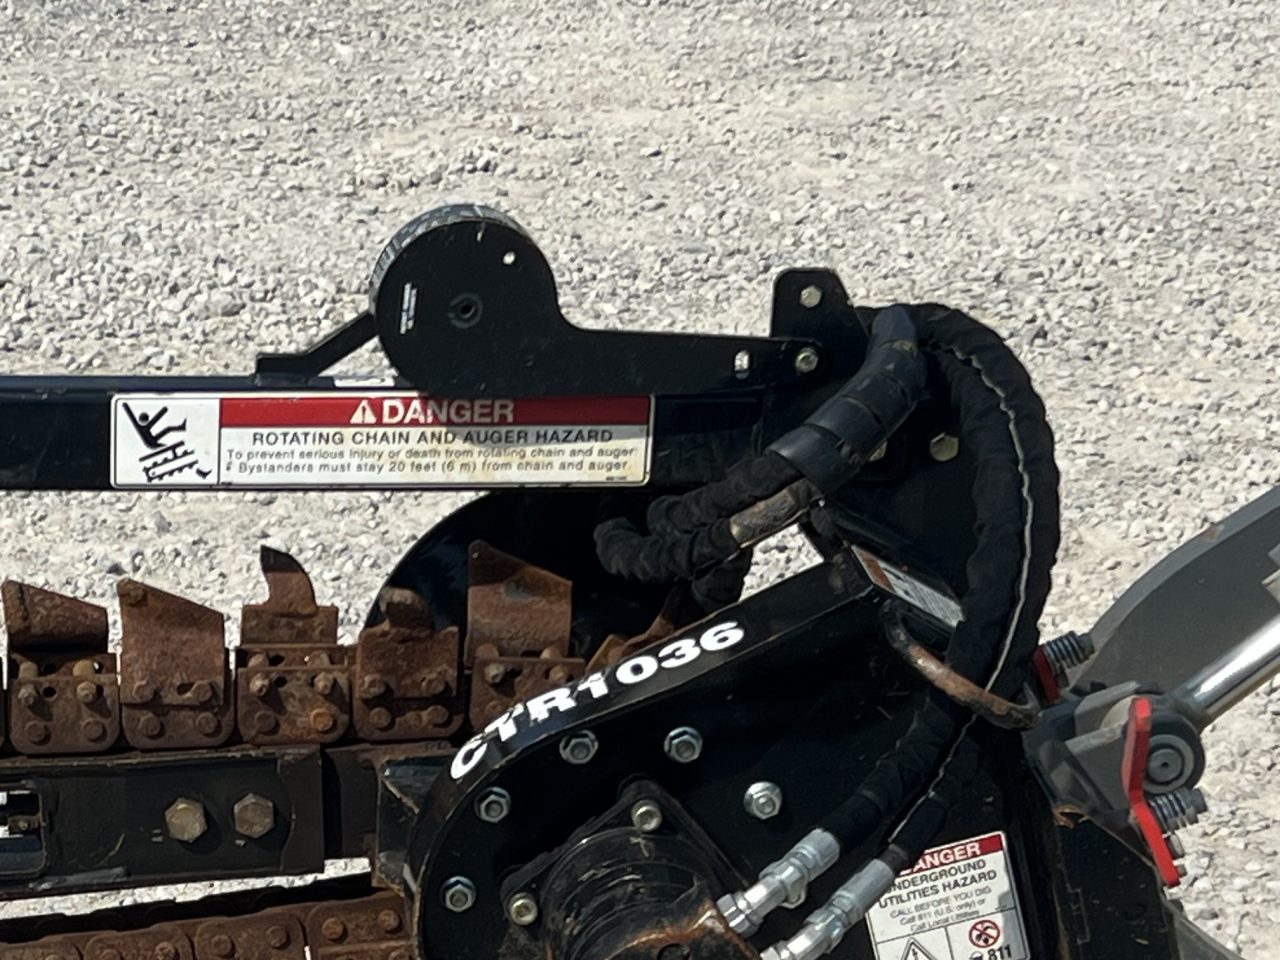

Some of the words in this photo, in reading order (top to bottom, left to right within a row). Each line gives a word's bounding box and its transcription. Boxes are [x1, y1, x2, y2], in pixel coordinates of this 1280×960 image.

[382, 399, 515, 424] DANGER
[252, 431, 345, 446] ROTATING
[352, 430, 410, 445] CHAIN
[417, 430, 457, 444] AND
[463, 430, 528, 444] AUGER
[536, 429, 613, 443] HAZARD
[227, 450, 243, 460] To
[247, 449, 295, 464] prevent
[299, 449, 345, 460] serious
[349, 449, 383, 464] injury
[388, 451, 400, 460] or
[405, 448, 441, 459] death
[445, 448, 474, 459] from
[477, 447, 526, 461] rotating
[531, 447, 565, 458] chain
[569, 447, 594, 458] and
[239, 461, 314, 475] Bystanders
[320, 461, 351, 472] must
[356, 461, 384, 475] stay
[388, 460, 406, 473] 20
[410, 460, 436, 472] feet
[441, 459, 455, 474] (6
[459, 460, 477, 473] m)
[481, 460, 513, 471] from
[516, 459, 554, 471] chain
[558, 459, 584, 471] and
[450, 621, 745, 779] CTR1036
[900, 842, 982, 876] ANGER
[878, 884, 940, 909] UTILITIES
[941, 869, 998, 893] HAZARD
[890, 905, 912, 919] CALL
[914, 897, 952, 913] BEFORE
[954, 891, 973, 903] YOU
